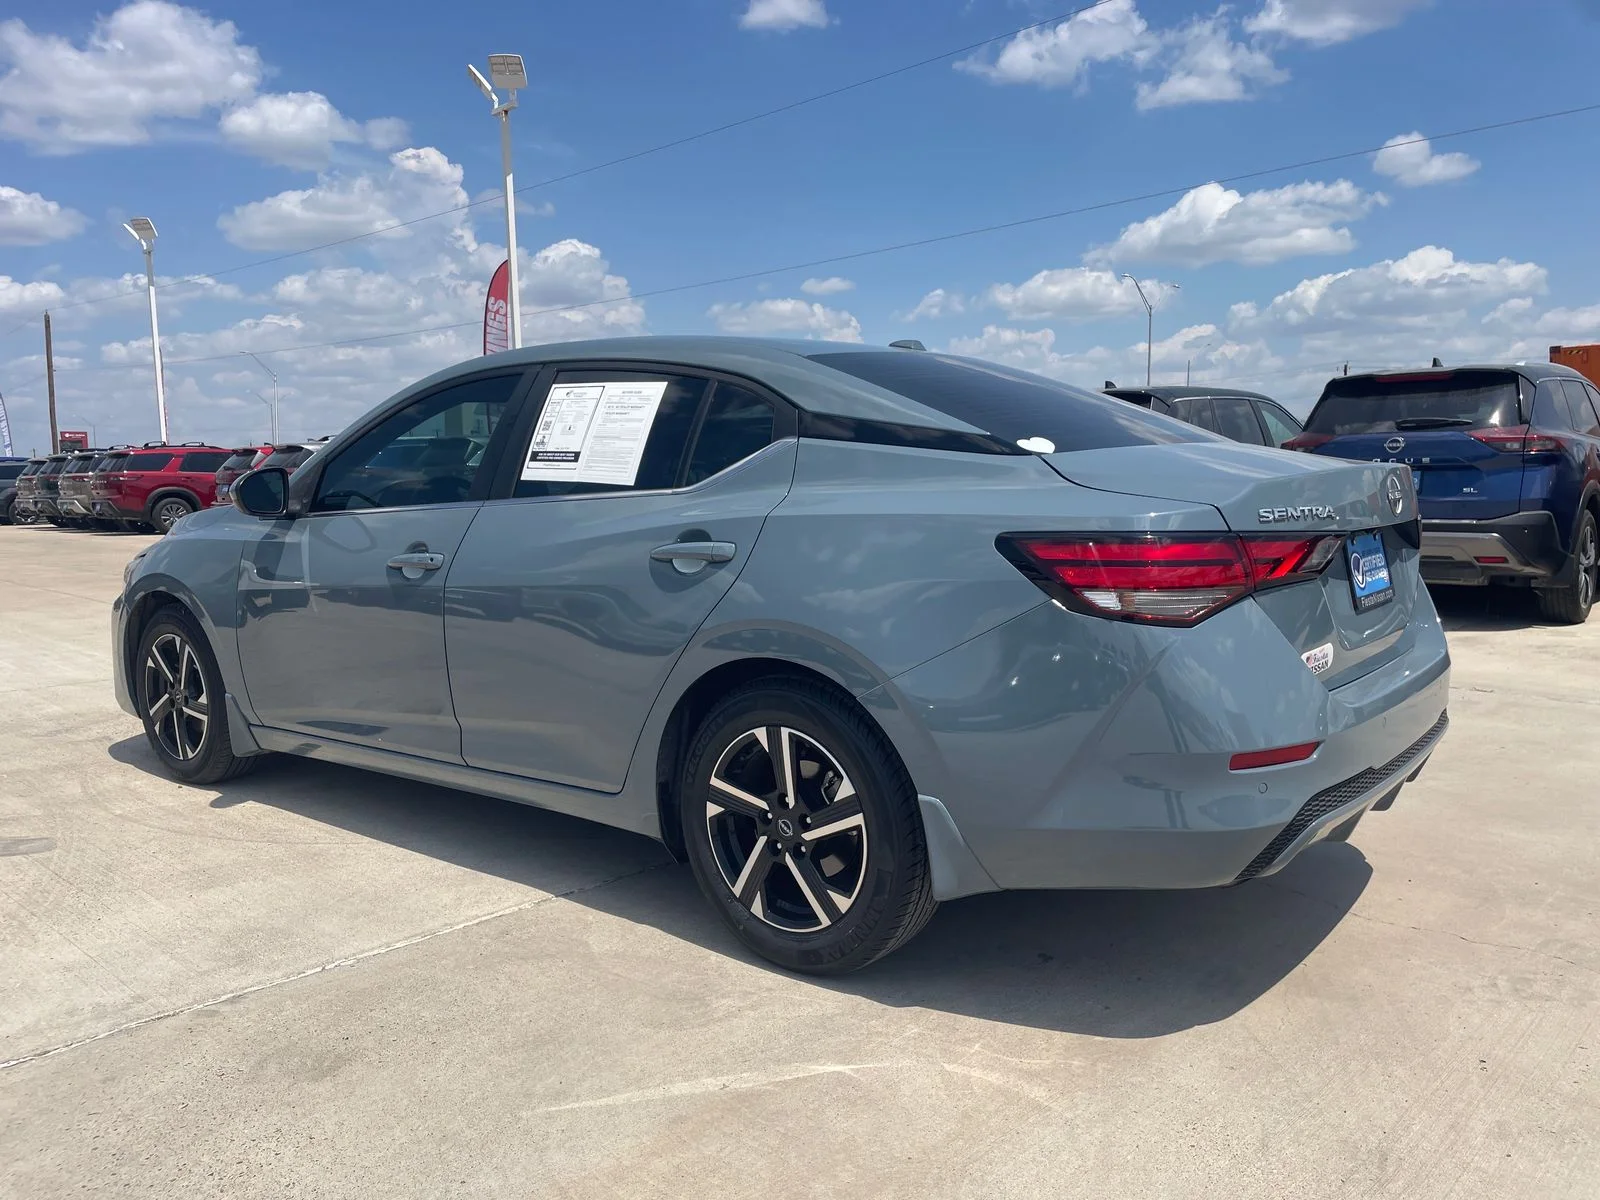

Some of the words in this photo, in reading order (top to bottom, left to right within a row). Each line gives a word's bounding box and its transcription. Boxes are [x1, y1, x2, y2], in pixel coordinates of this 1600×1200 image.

[486, 296, 508, 353] INGS
[1258, 505, 1334, 522] SENTRA
[1311, 660, 1329, 674] ISSAN
